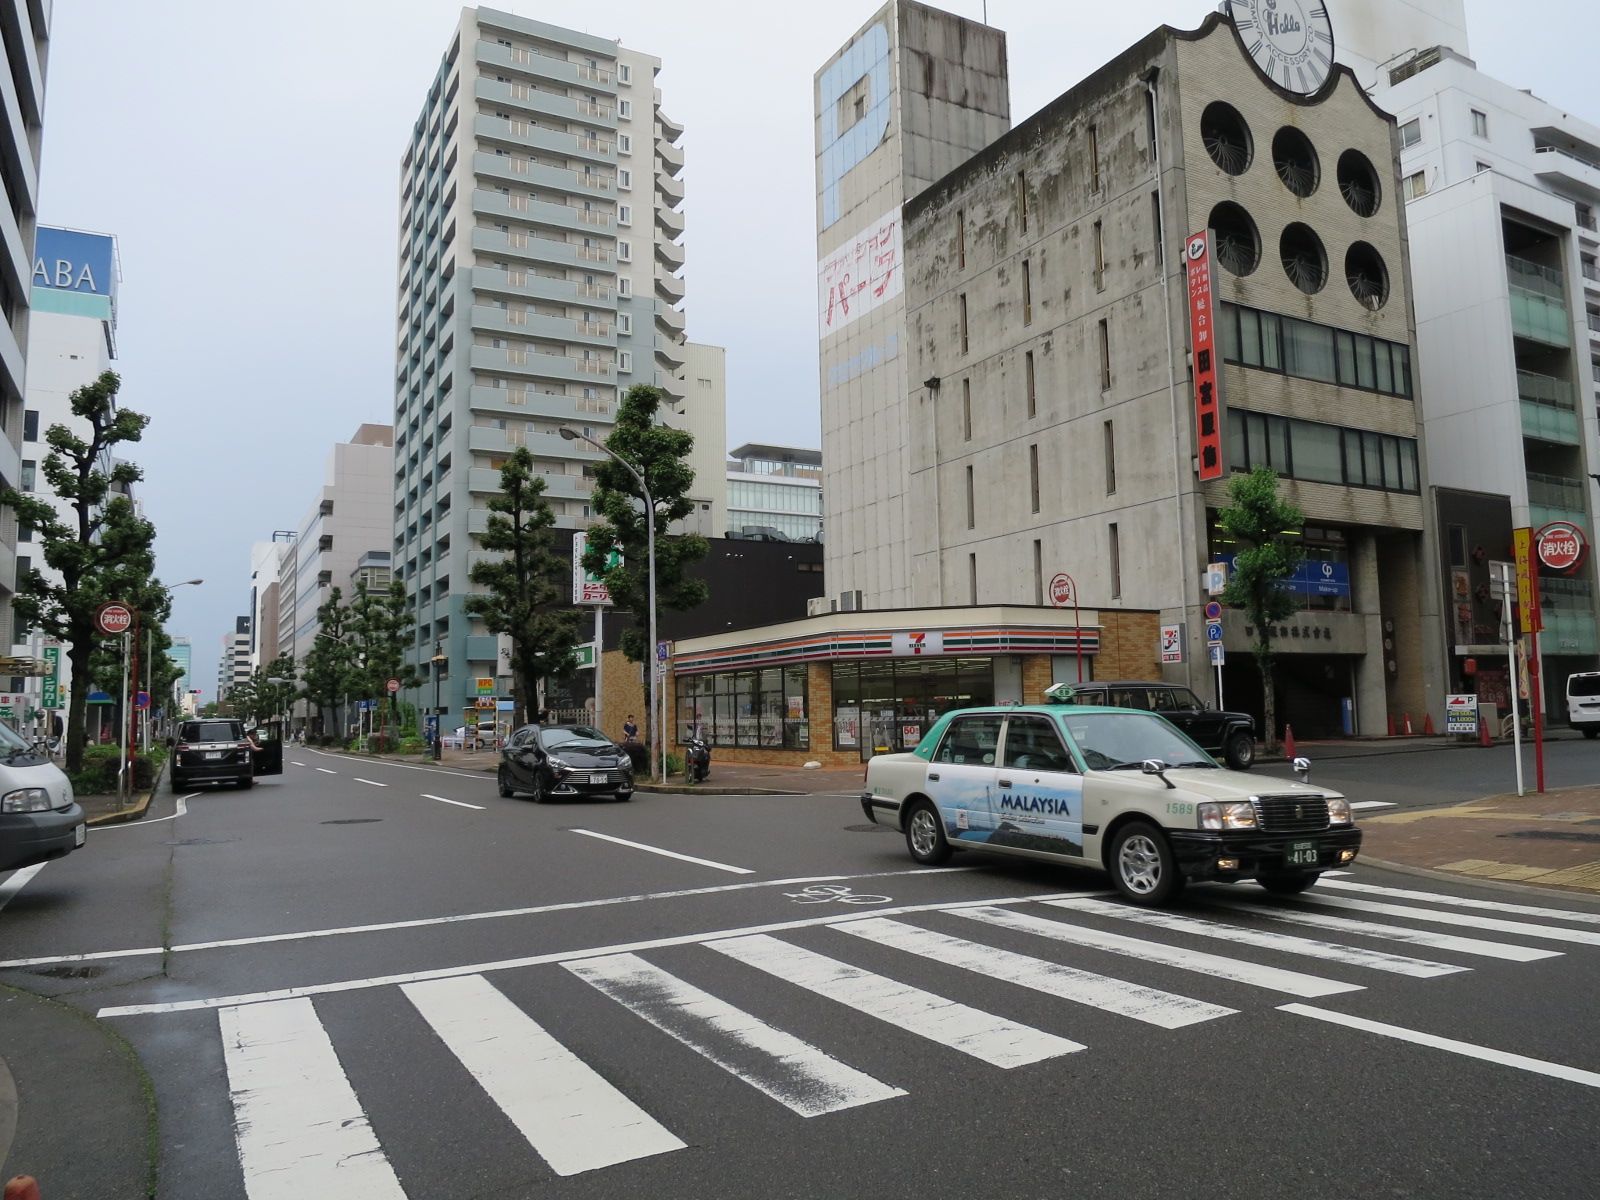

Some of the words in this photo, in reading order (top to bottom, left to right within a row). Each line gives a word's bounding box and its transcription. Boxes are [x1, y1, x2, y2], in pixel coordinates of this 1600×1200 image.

[33, 257, 97, 291] ABA
[1543, 541, 1575, 556] 消火栓
[1211, 573, 1223, 588] P
[103, 614, 128, 624] 消火栓
[909, 632, 926, 655] 7
[1467, 696, 1474, 704] P
[1001, 794, 1070, 816] MALAYSIA
[1166, 803, 1192, 815] 1589
[1293, 850, 1317, 864] 41-03
